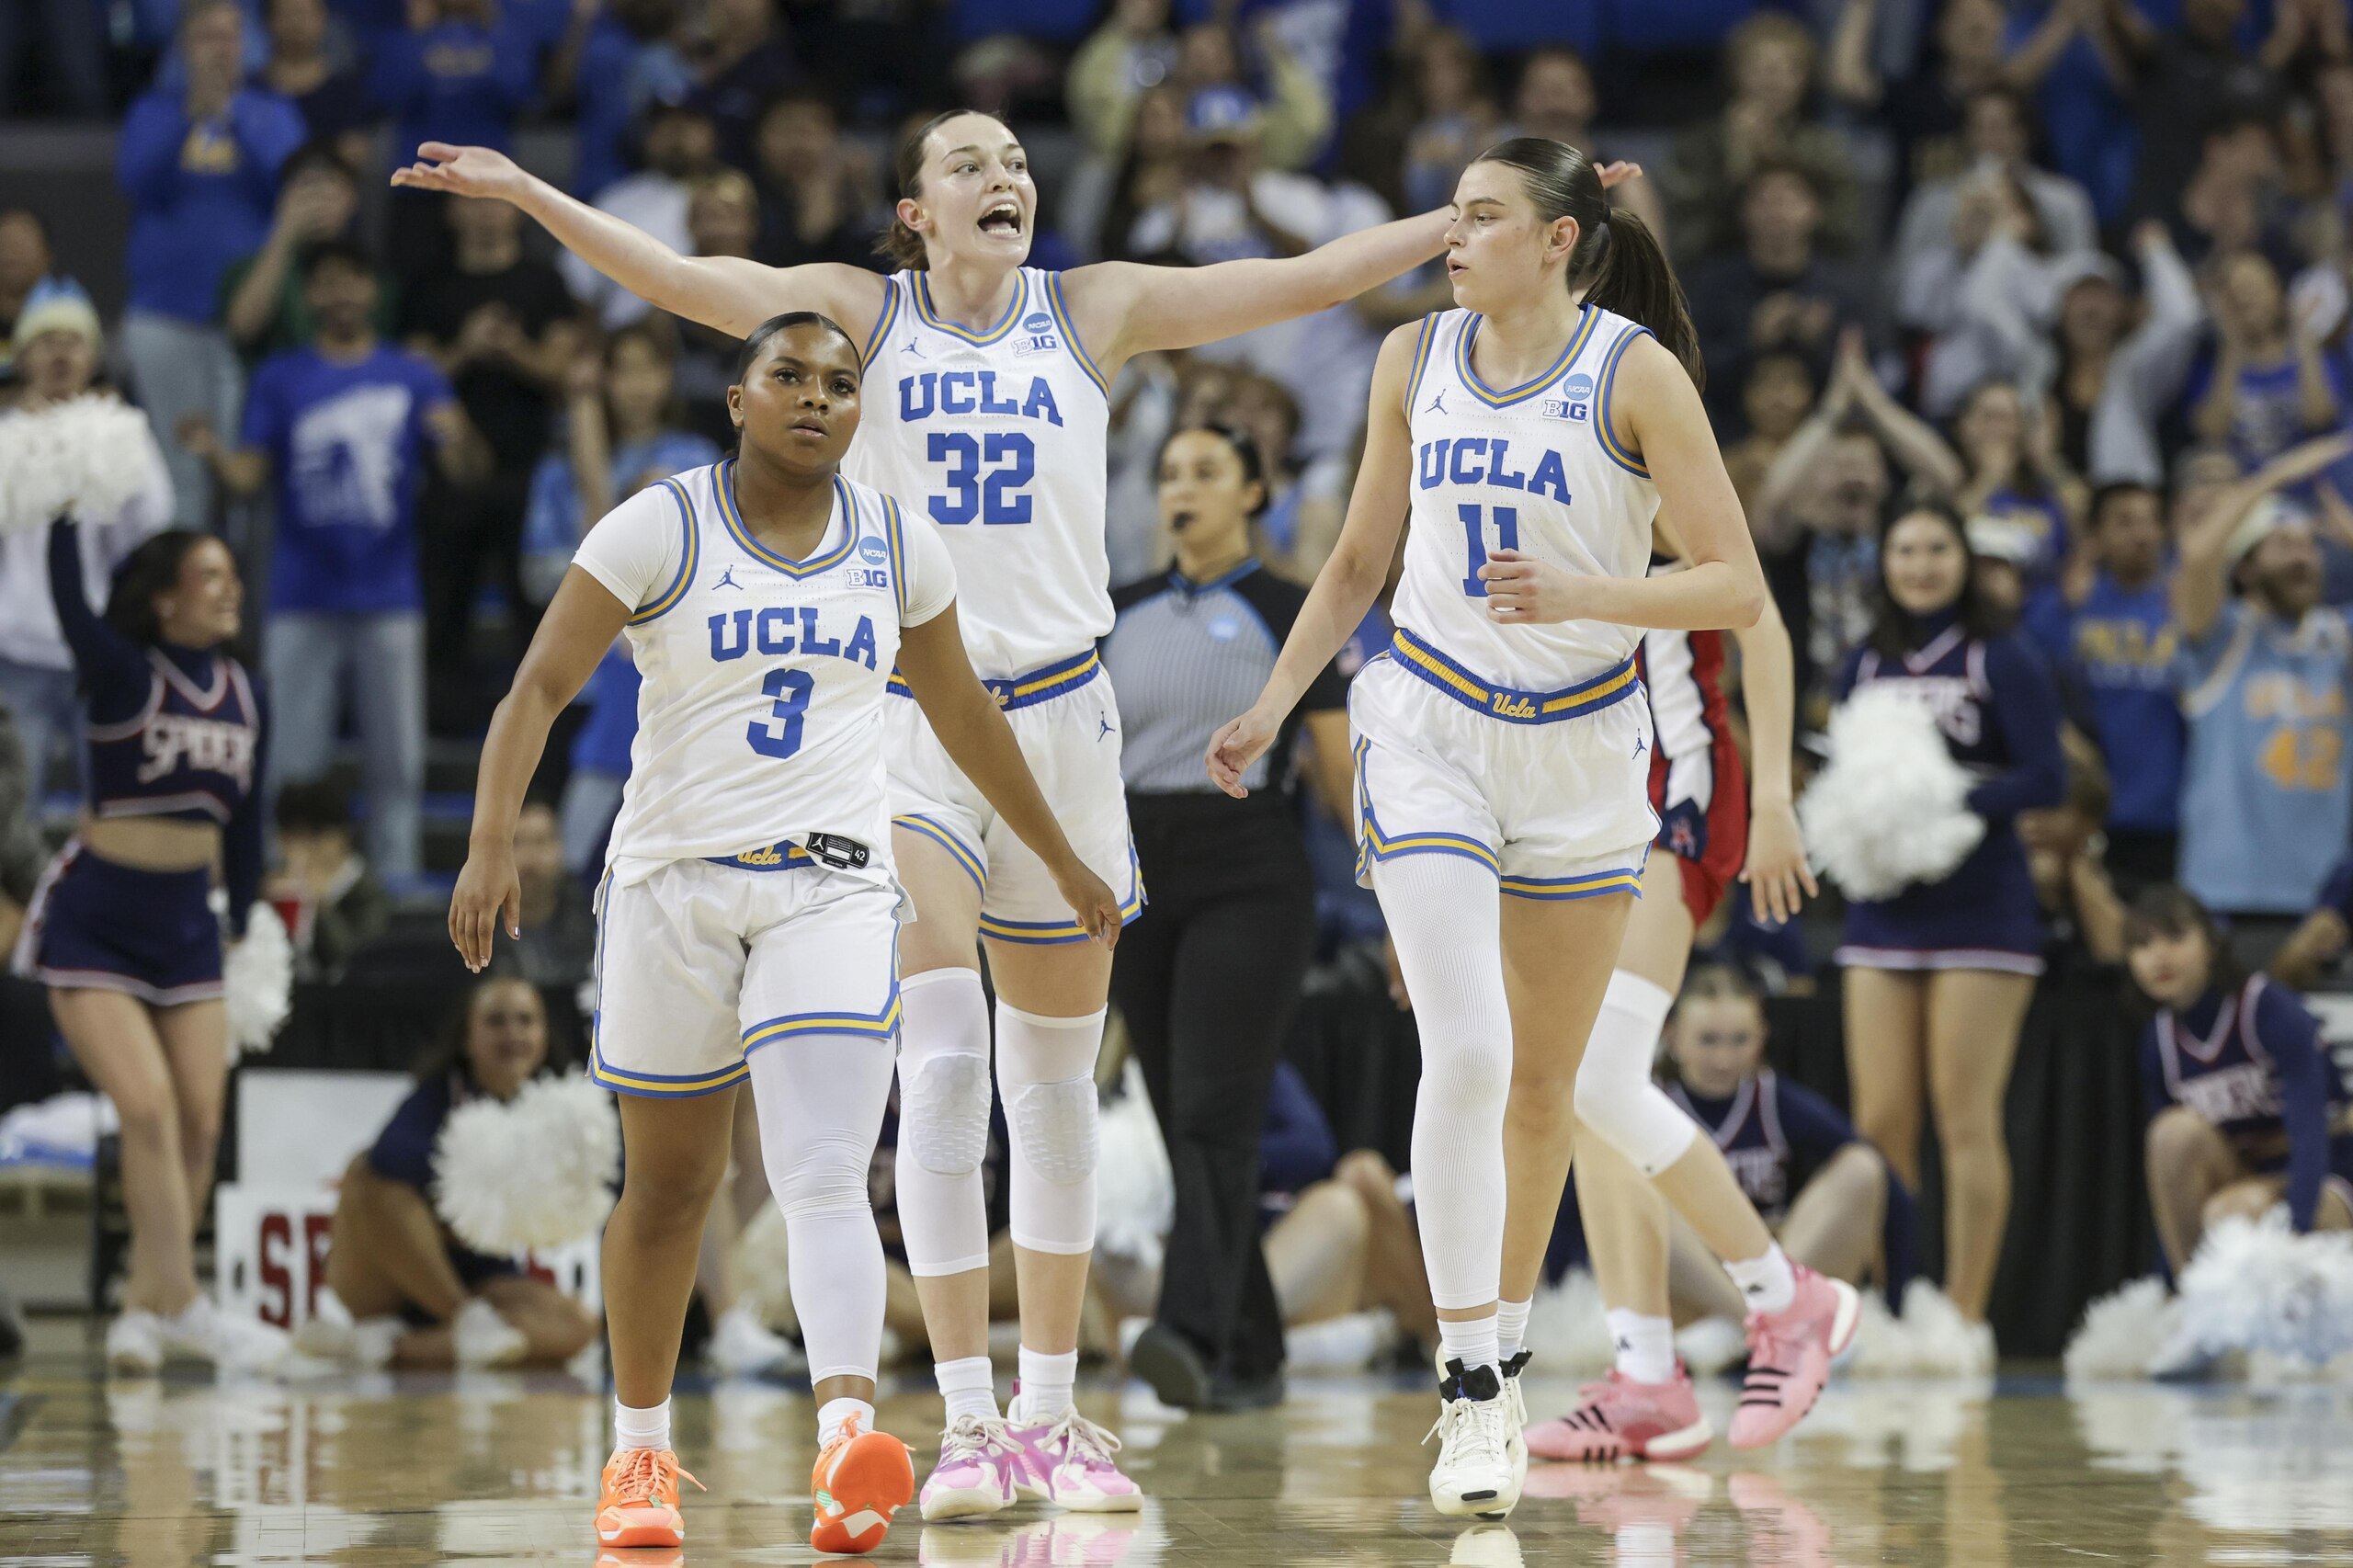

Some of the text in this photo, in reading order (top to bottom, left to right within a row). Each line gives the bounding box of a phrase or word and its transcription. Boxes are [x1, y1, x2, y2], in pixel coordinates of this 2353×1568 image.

[899, 370, 1063, 428] UCLA
[1566, 384, 1591, 394] NCAA
[926, 432, 1035, 525] 32
[1419, 437, 1572, 506] UCLA
[863, 548, 886, 558] NCAA
[708, 607, 878, 672] UCLA
[746, 667, 815, 759] 3
[1493, 692, 1537, 719] Ucla
[854, 849, 866, 862] 42
